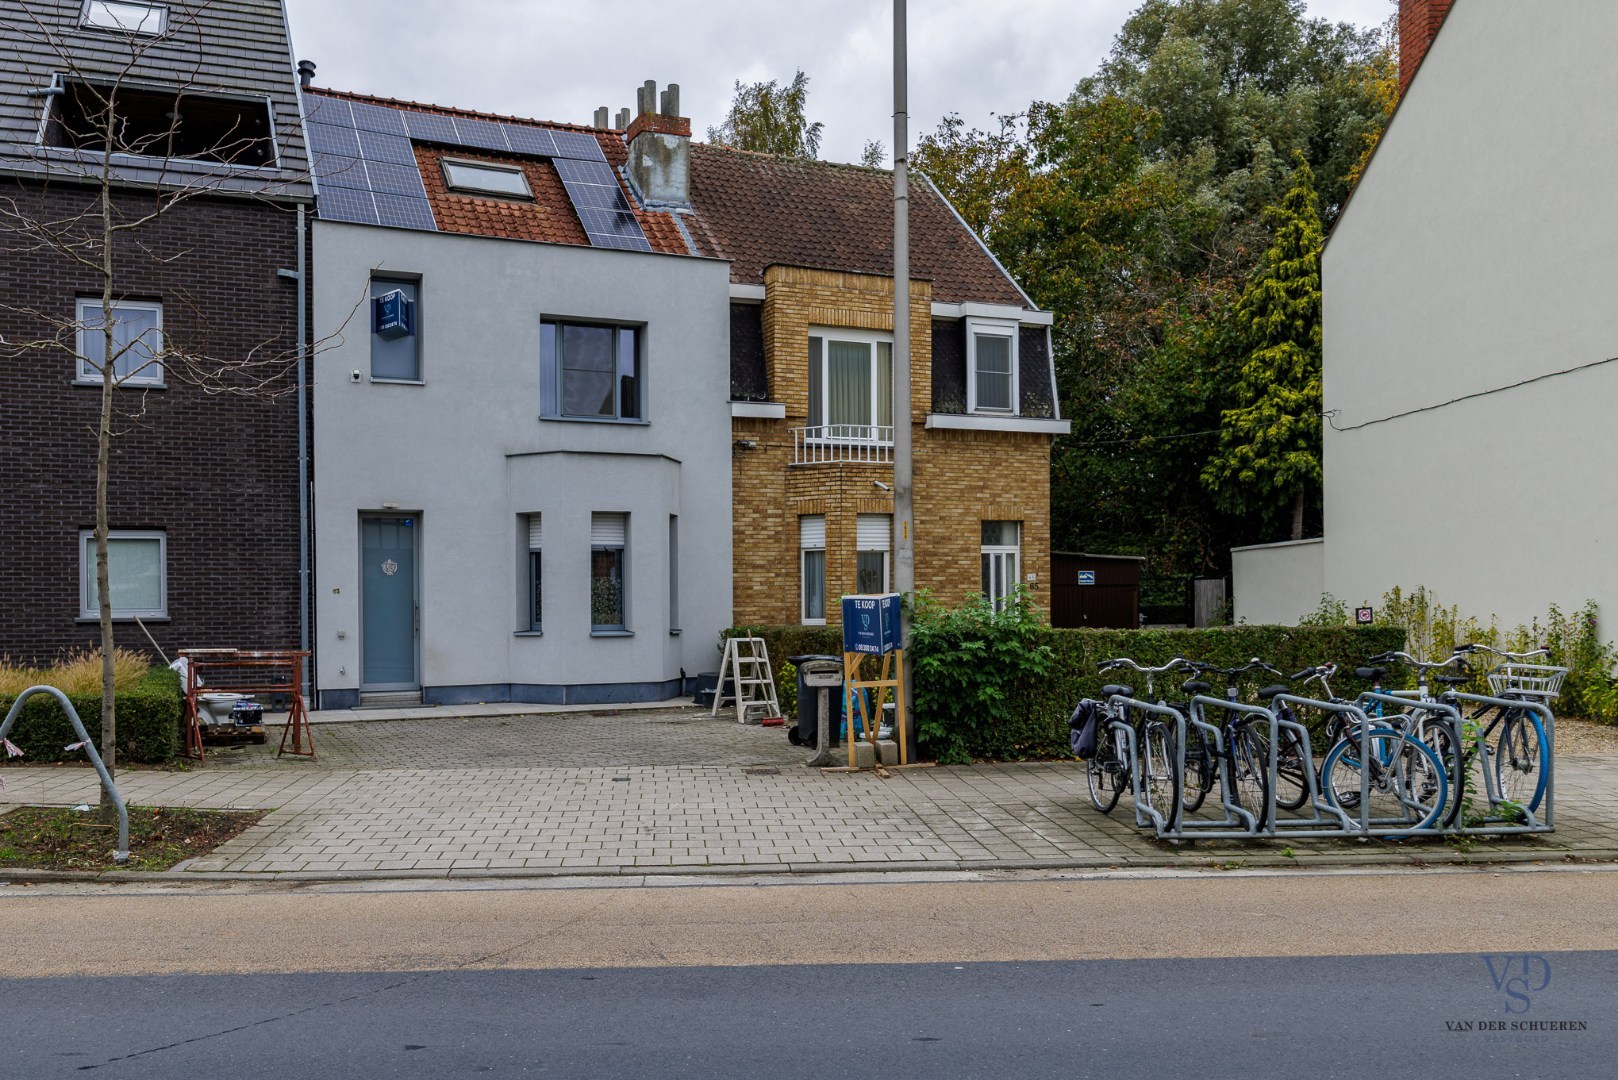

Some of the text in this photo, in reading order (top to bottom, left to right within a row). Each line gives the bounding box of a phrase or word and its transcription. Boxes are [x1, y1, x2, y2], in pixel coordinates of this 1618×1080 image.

[1030, 582, 1039, 590] 65
[855, 600, 875, 609] TE KOOP
